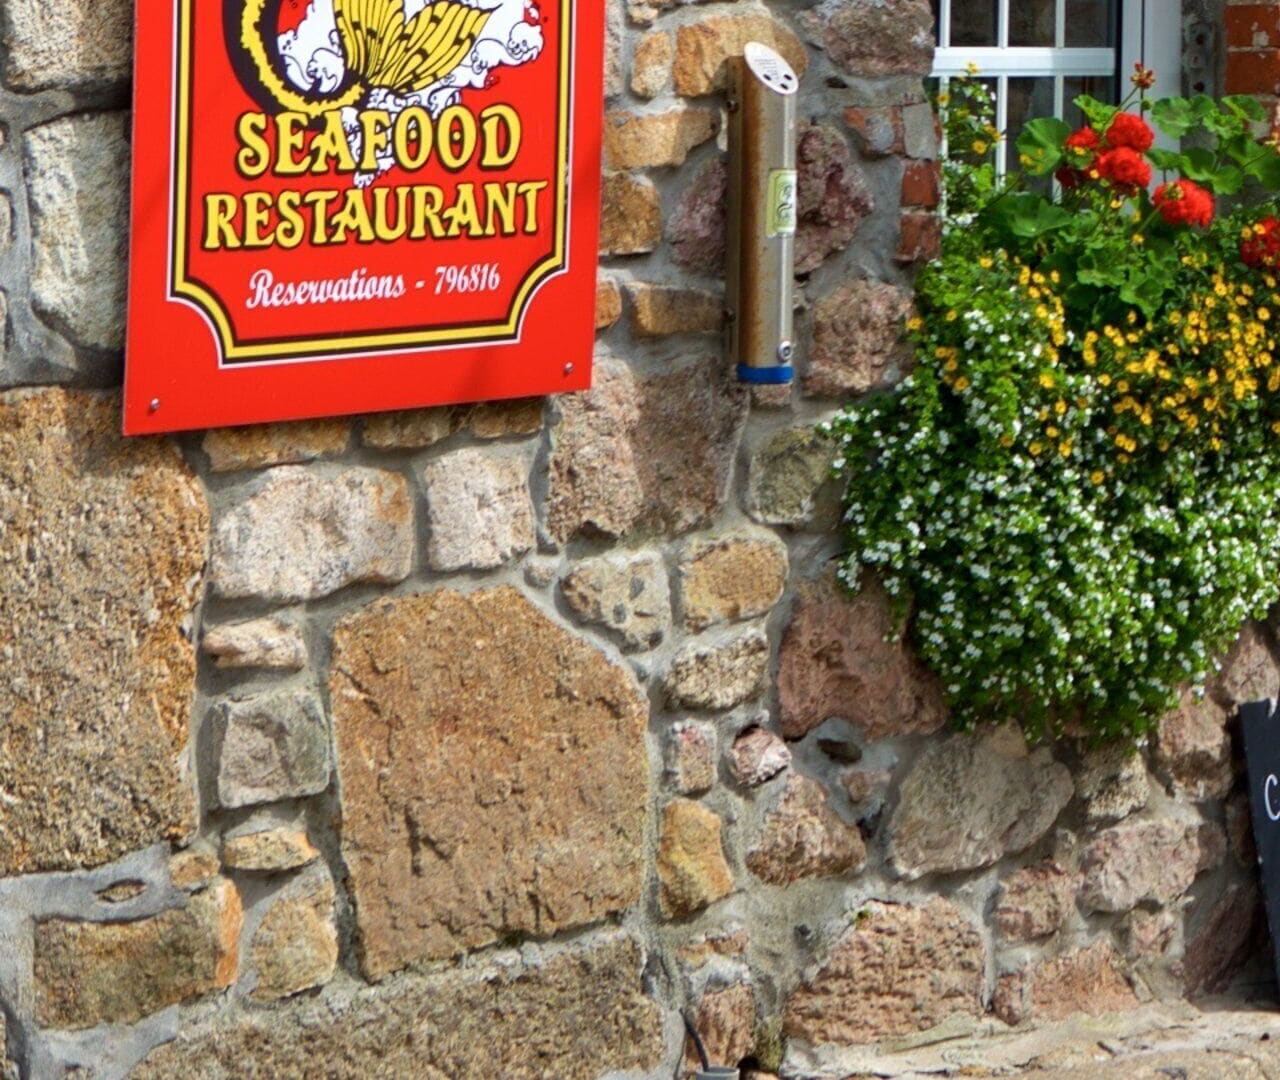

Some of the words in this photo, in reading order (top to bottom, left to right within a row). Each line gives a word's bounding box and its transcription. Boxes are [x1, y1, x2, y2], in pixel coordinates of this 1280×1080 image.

[235, 104, 523, 177] SEAFOOD
[202, 179, 548, 252] RESTAURANT
[245, 267, 407, 309] Reservations
[434, 263, 501, 296] 796816
